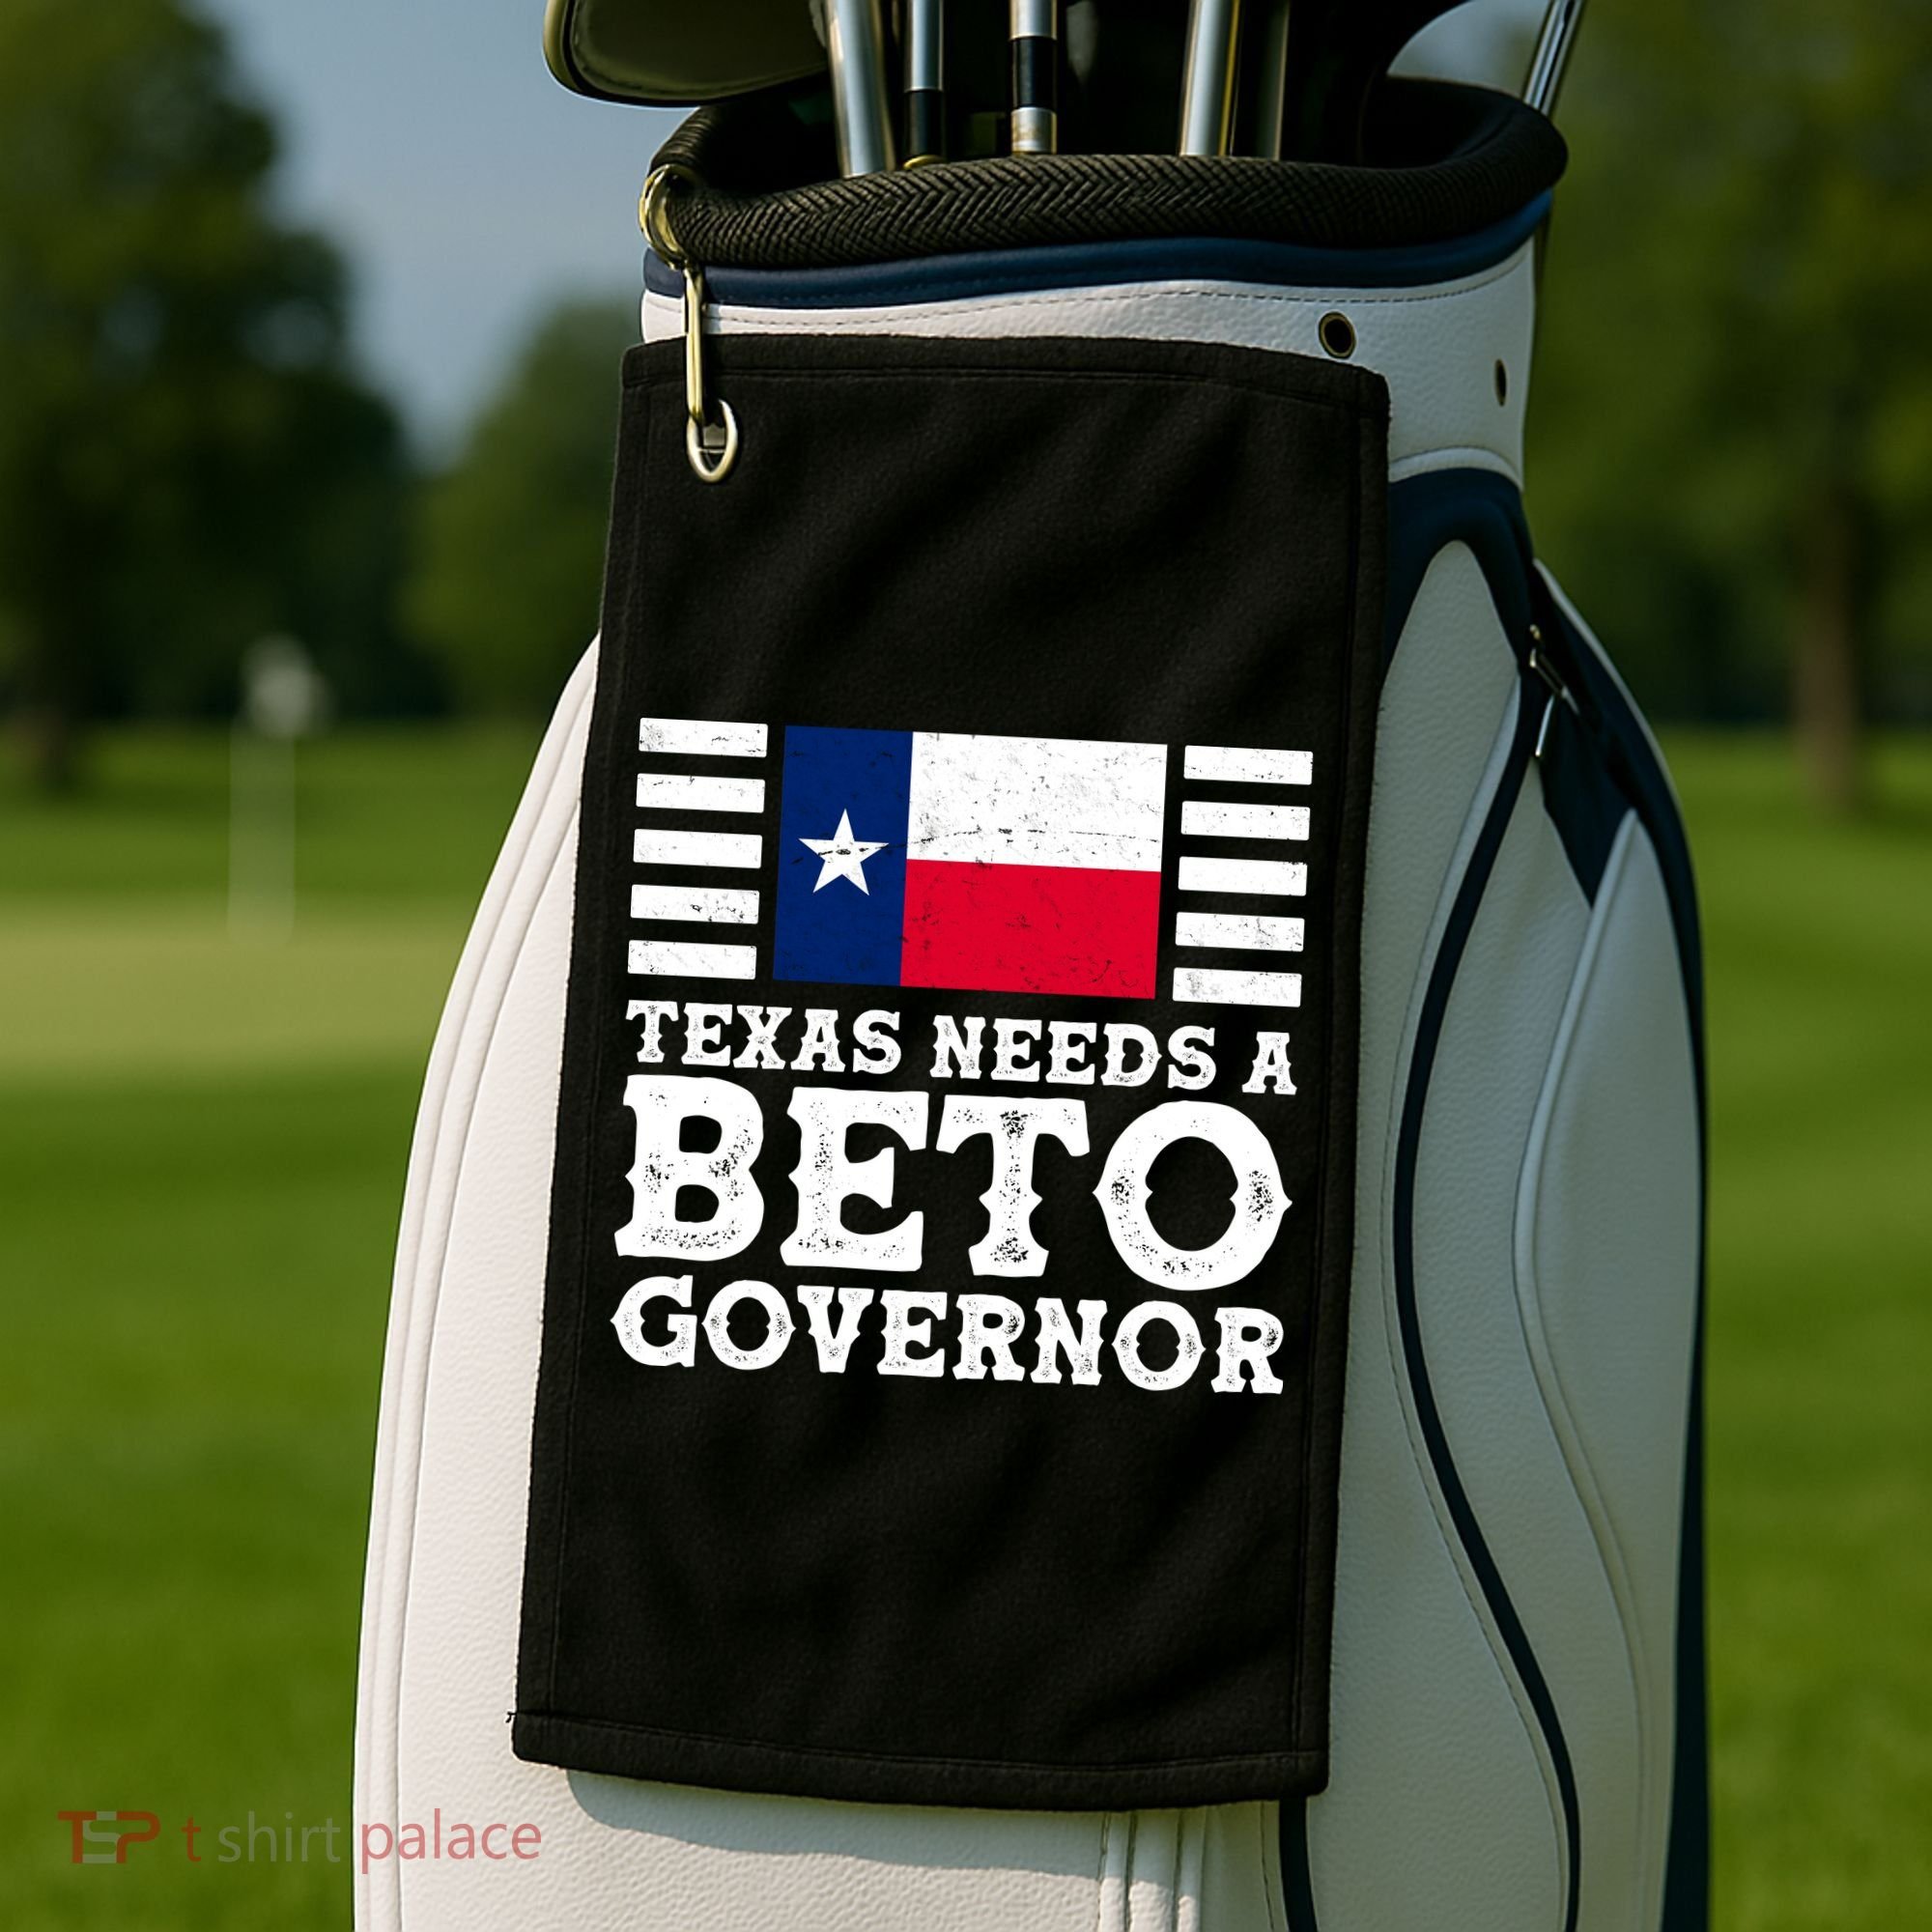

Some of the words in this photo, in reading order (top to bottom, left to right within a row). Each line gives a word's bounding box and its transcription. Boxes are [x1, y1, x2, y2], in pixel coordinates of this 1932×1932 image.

[626, 1000, 901, 1074] TEXAS
[930, 1014, 1216, 1091] NEEDS
[1242, 1031, 1297, 1095] A
[614, 1073, 1293, 1291] BETO
[611, 1275, 1284, 1395] GOVERNOR
